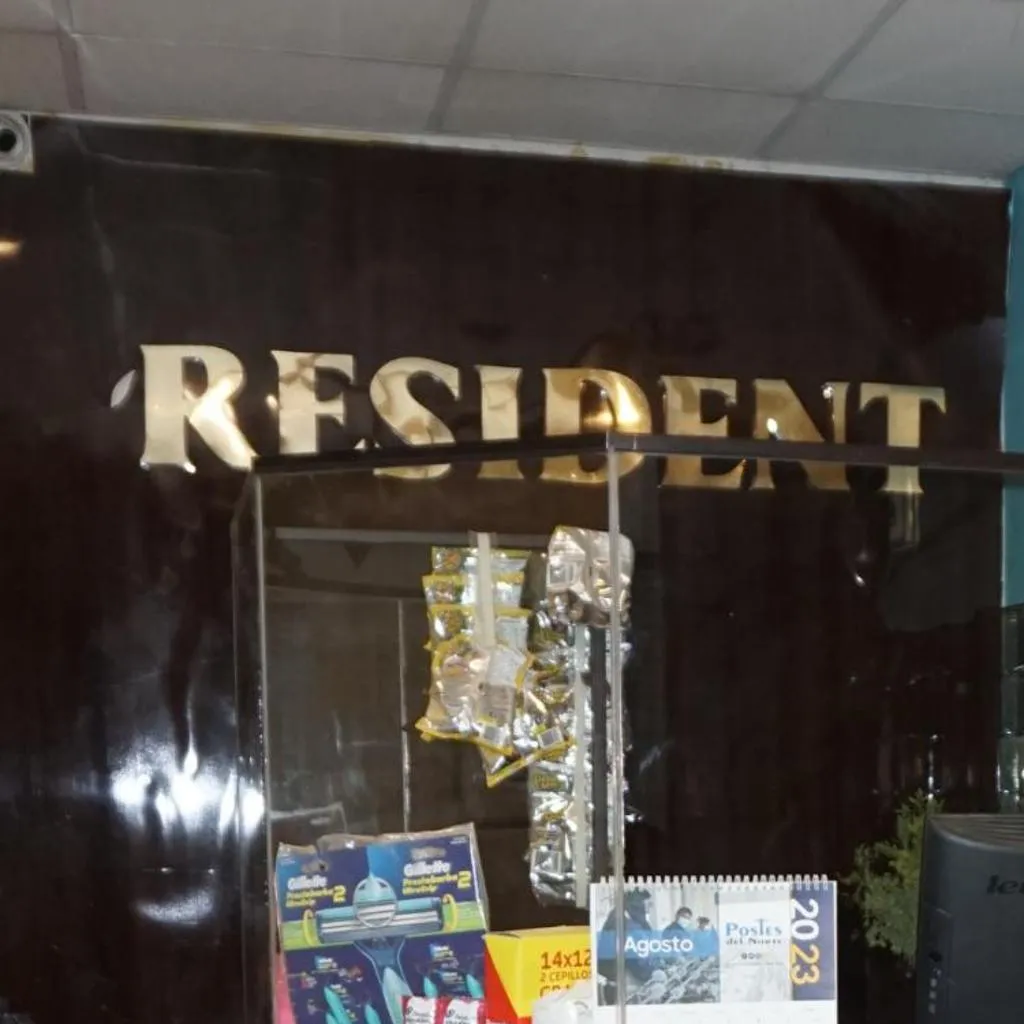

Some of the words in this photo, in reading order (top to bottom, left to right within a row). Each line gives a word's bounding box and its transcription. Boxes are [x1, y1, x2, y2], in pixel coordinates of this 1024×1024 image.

[138, 344, 946, 494] RESIDENT
[404, 859, 450, 877] Gillette
[457, 870, 472, 889] 2
[333, 884, 346, 903] 2
[624, 935, 695, 958] Agosto
[790, 898, 820, 986] 2023
[540, 949, 592, 970] 14x12
[548, 969, 592, 983] CEPILLO
